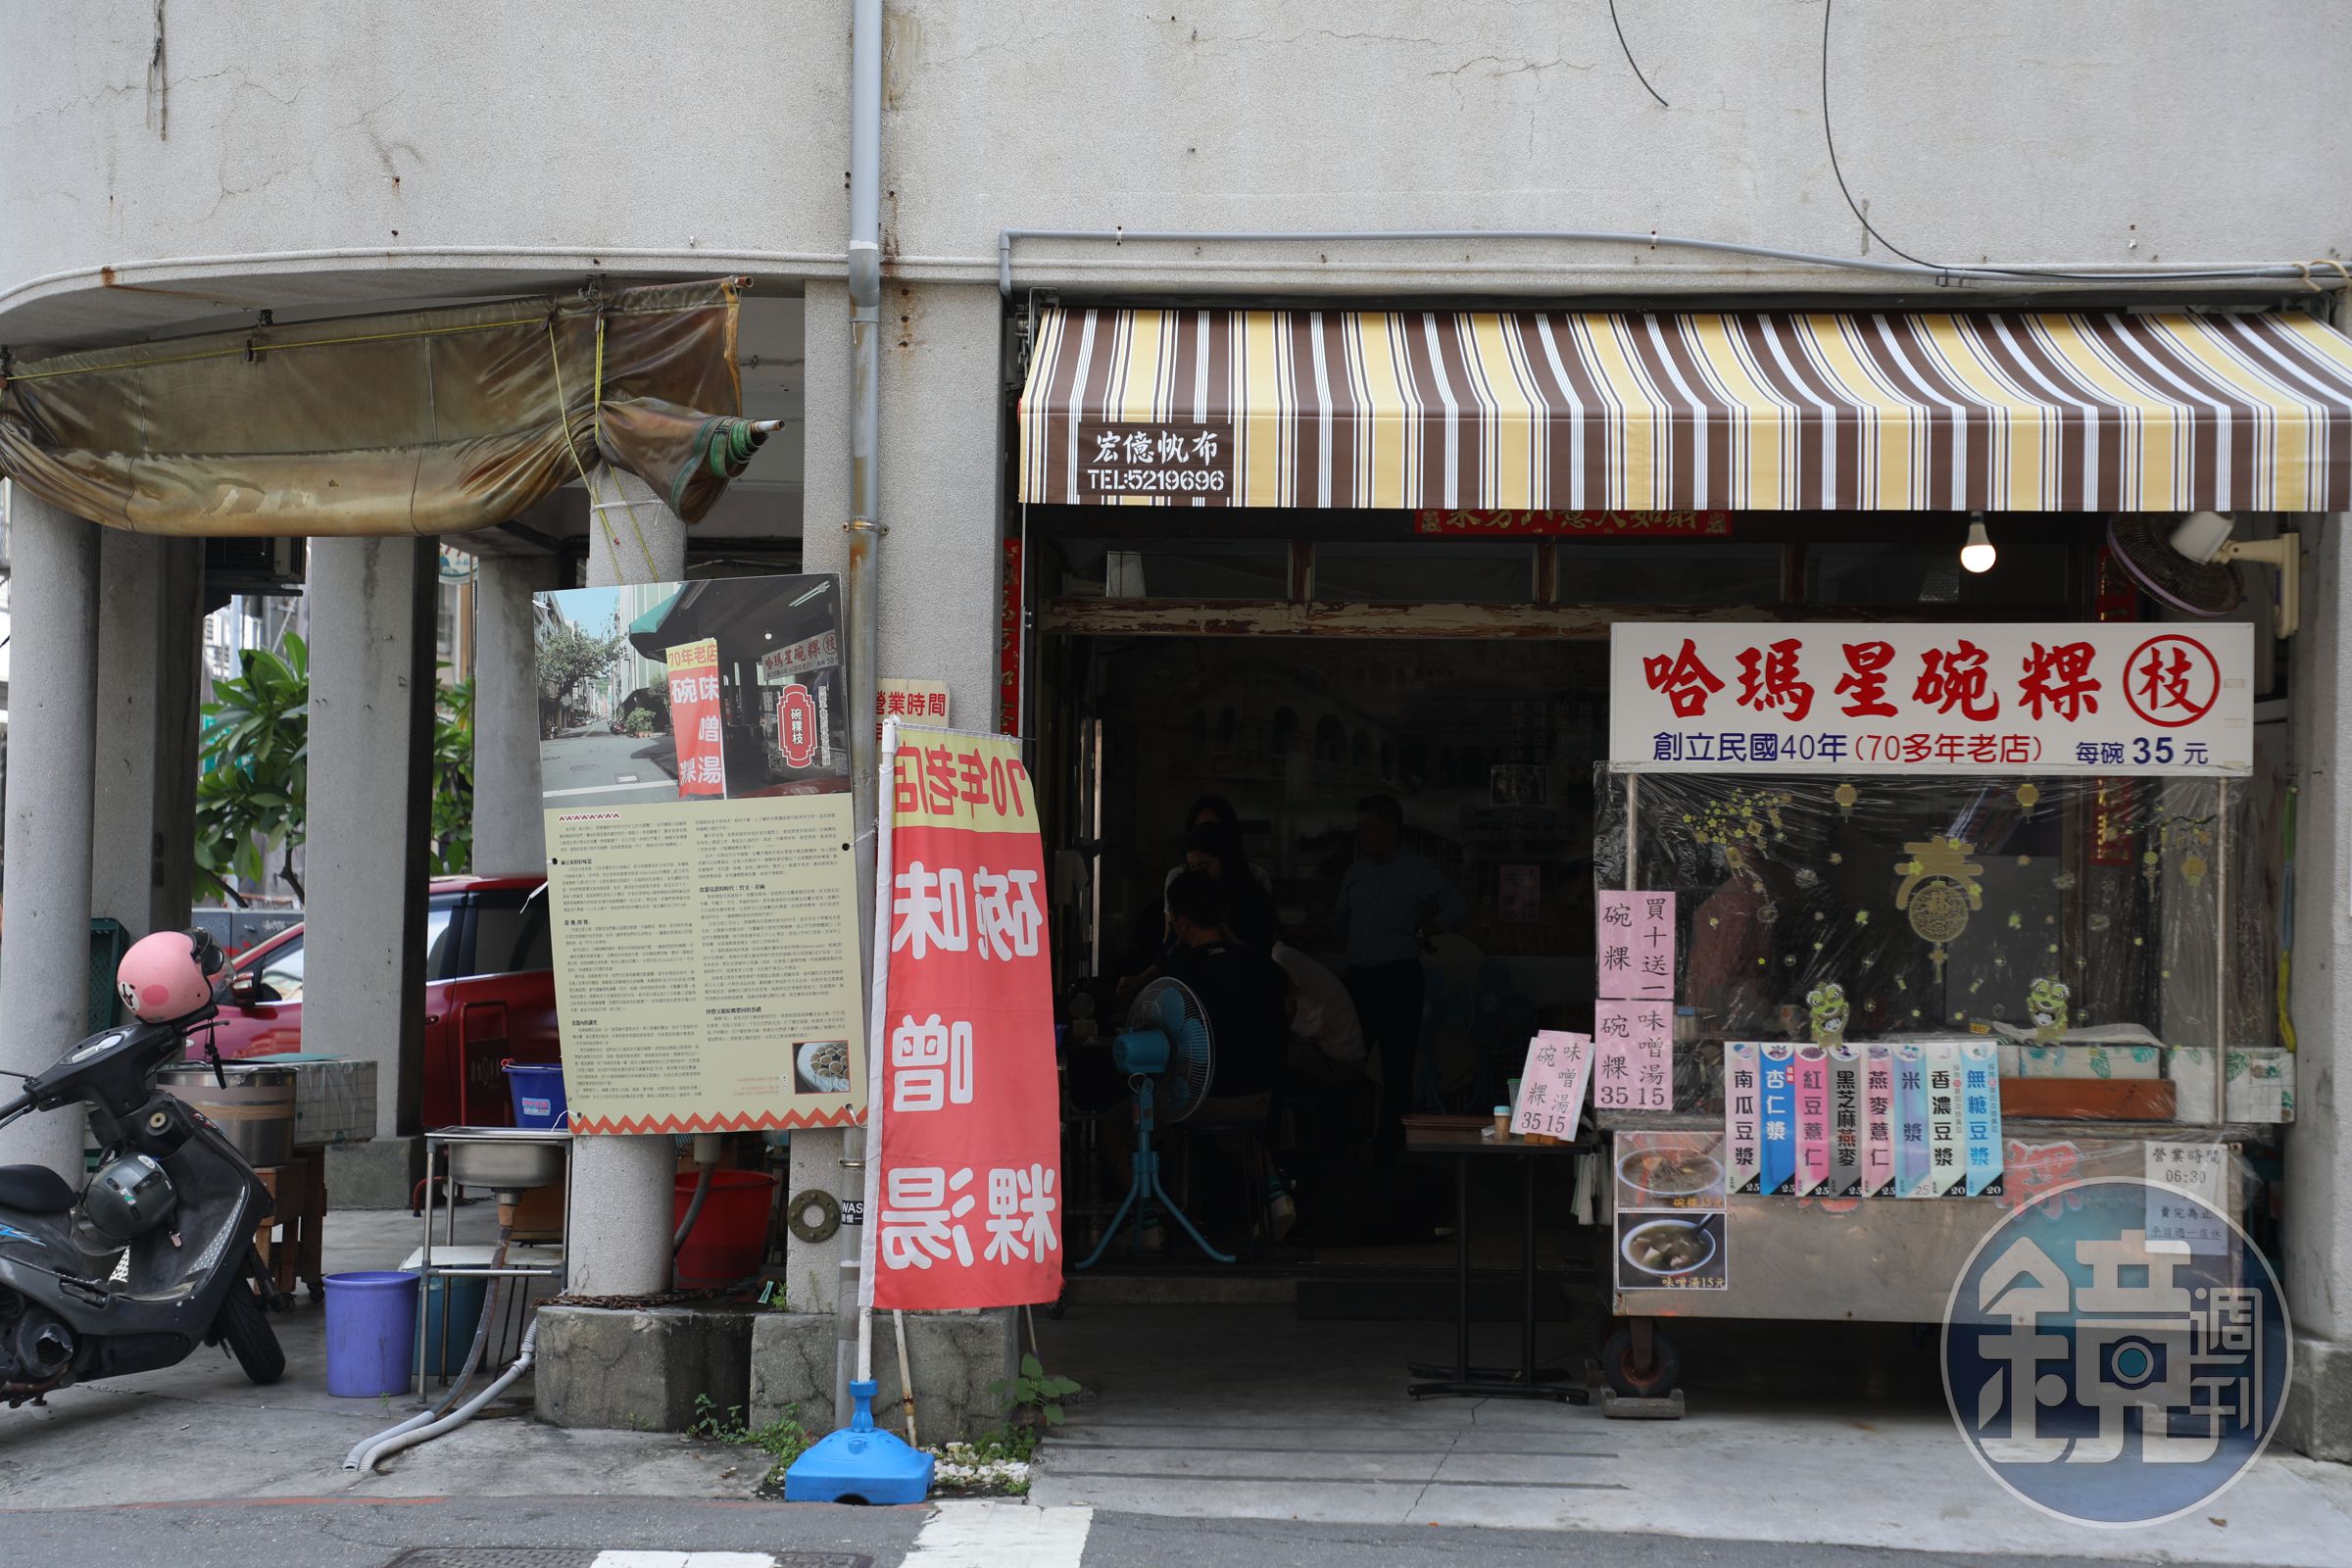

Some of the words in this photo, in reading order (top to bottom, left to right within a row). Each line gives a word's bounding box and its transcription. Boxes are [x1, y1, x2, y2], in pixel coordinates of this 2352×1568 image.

[1092, 429, 1218, 466] 宏億帆布
[1087, 469, 1225, 490] TEL:5219696
[667, 643, 718, 667] 70年老店
[1643, 638, 2099, 722] 哈瑪星碗粿
[876, 690, 946, 717] 營業時間
[697, 674, 723, 785] 味噌湯
[790, 708, 804, 745] 碗粿枝
[1601, 903, 1633, 971] 碗粿
[1641, 897, 1670, 990] 買十送一
[1599, 1013, 1630, 1080] 碗粿
[1638, 1009, 1667, 1085] 味噌湯
[1599, 1086, 1630, 1105] 35
[1638, 1087, 1666, 1106] 15
[1765, 1069, 1787, 1141] 杏仁漿
[1520, 1111, 1542, 1131] 35
[1544, 1113, 1566, 1133] 15
[1734, 1069, 1754, 1166] 南瓜豆漿
[1803, 1070, 1823, 1166] 紅豆薏仁
[1836, 1070, 1856, 1167] 黑芝麻燕麥
[1868, 1070, 1889, 1167] 燕麥薏仁
[1932, 1070, 1954, 1166] 香濃豆漿
[1967, 1069, 1989, 1166] 無糖豆漿
[2152, 1146, 2220, 1164] 營業時間
[1745, 1183, 1760, 1192] 25
[1782, 1184, 1795, 1193] 25
[1815, 1186, 1829, 1196] 25
[1882, 1187, 1896, 1196] 25
[1951, 1186, 1966, 1195] 20
[1986, 1186, 2001, 1195] 20
[2166, 1169, 2207, 1184] 06:30
